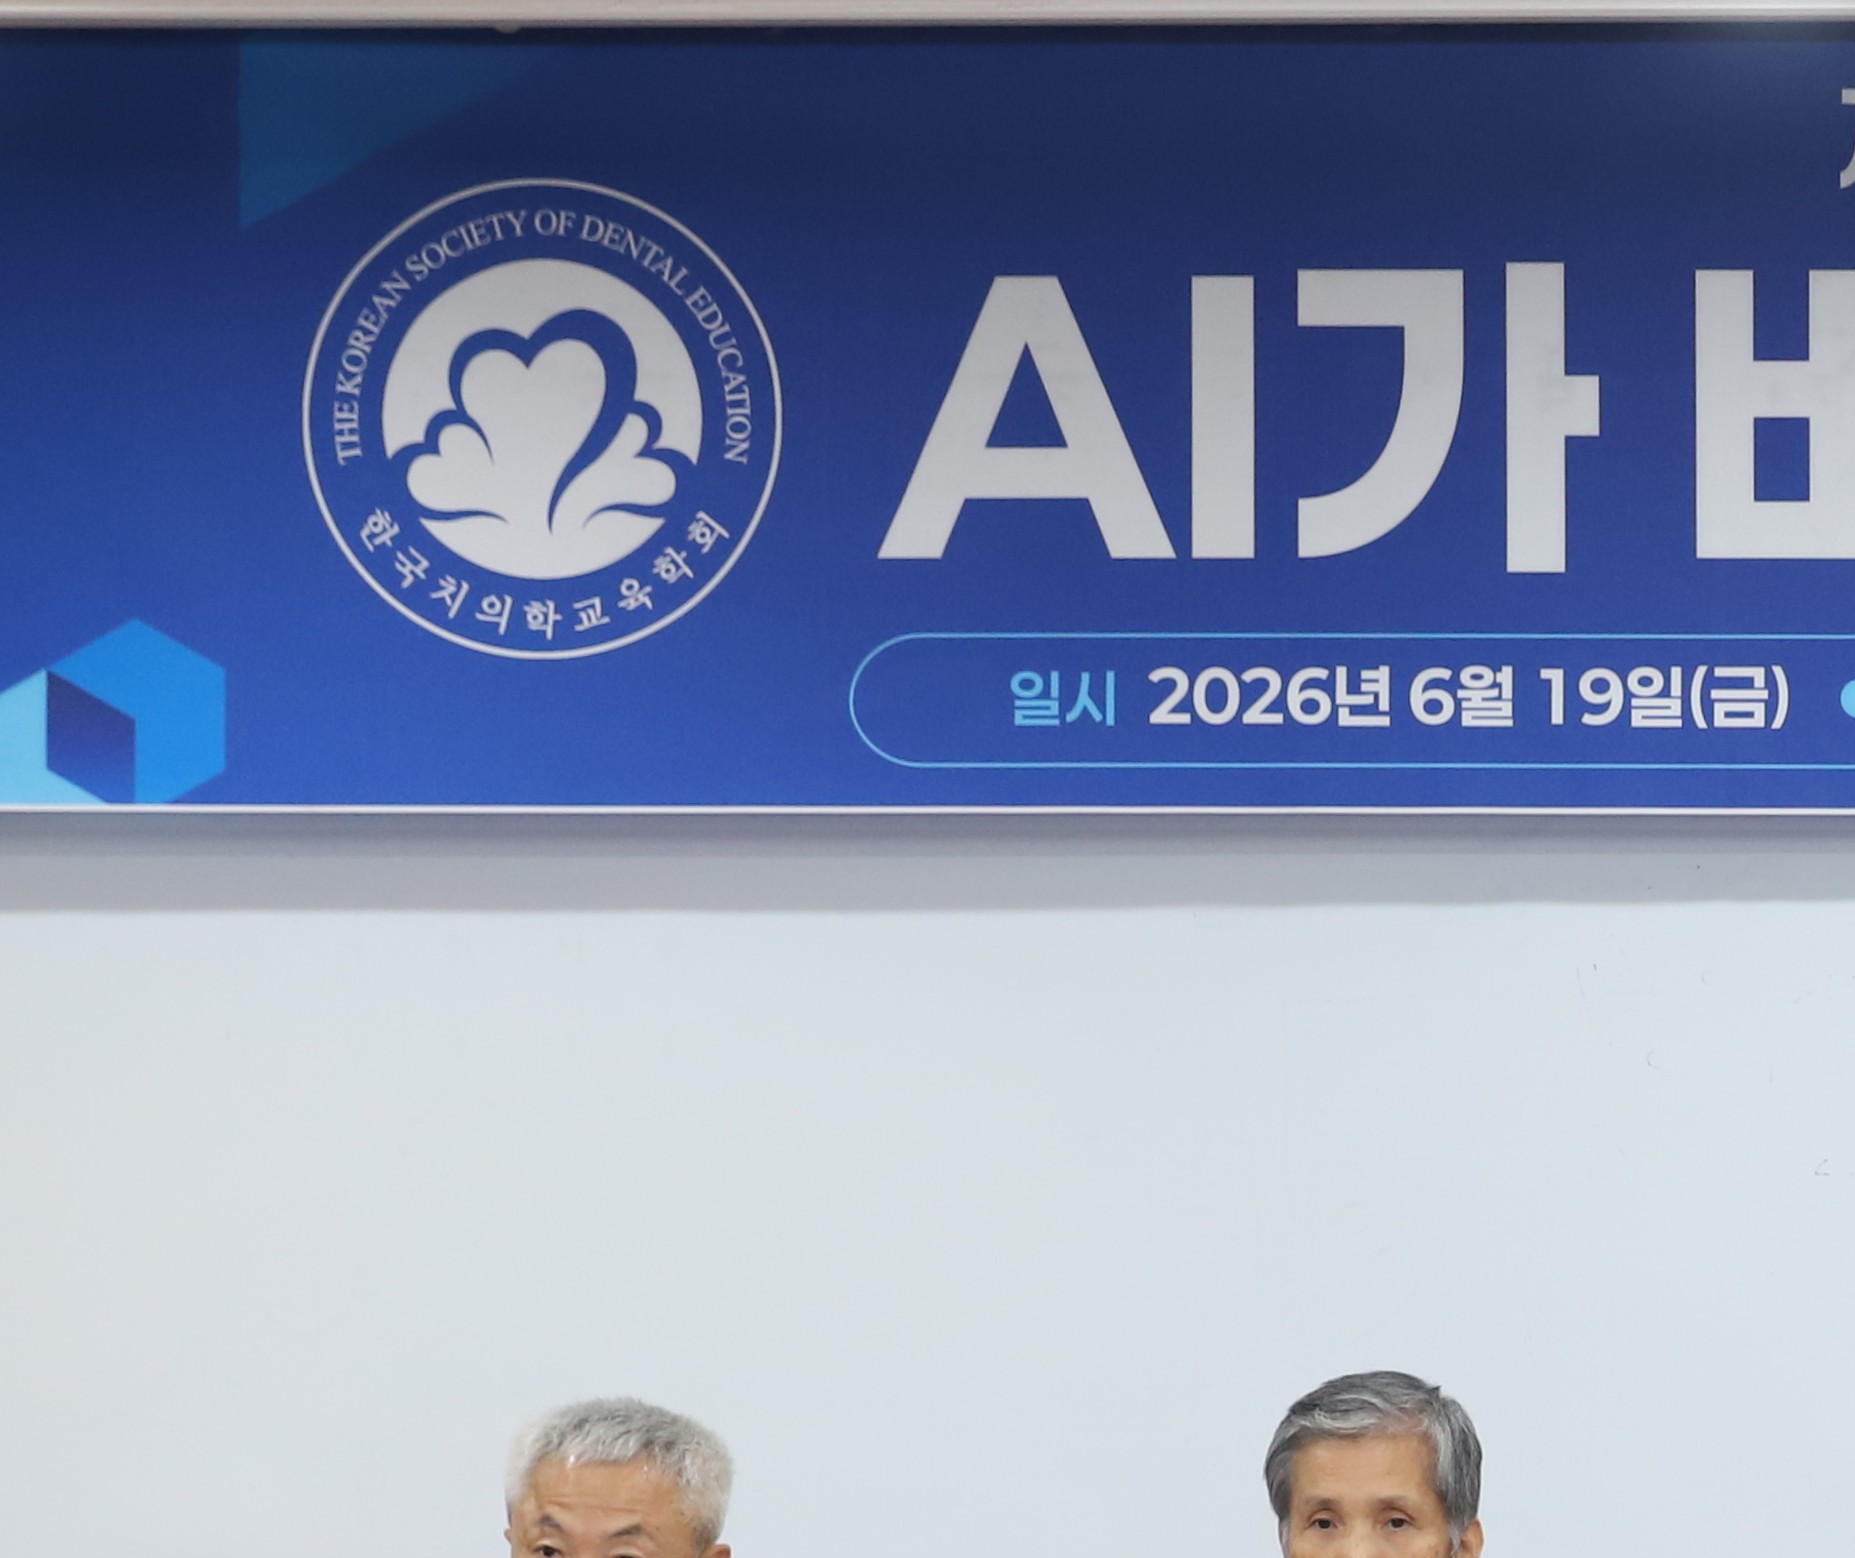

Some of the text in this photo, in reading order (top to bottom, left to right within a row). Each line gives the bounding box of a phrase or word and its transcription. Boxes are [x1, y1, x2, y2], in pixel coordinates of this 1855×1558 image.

[334, 208, 753, 467] THE KOREAN SOCIETY OF DENTAL EDUCATION
[878, 263, 1599, 572] AI가
[359, 507, 730, 640] 한국치의학교육학회
[1009, 665, 1789, 730] 일시 2026년 6월 19일(금)
